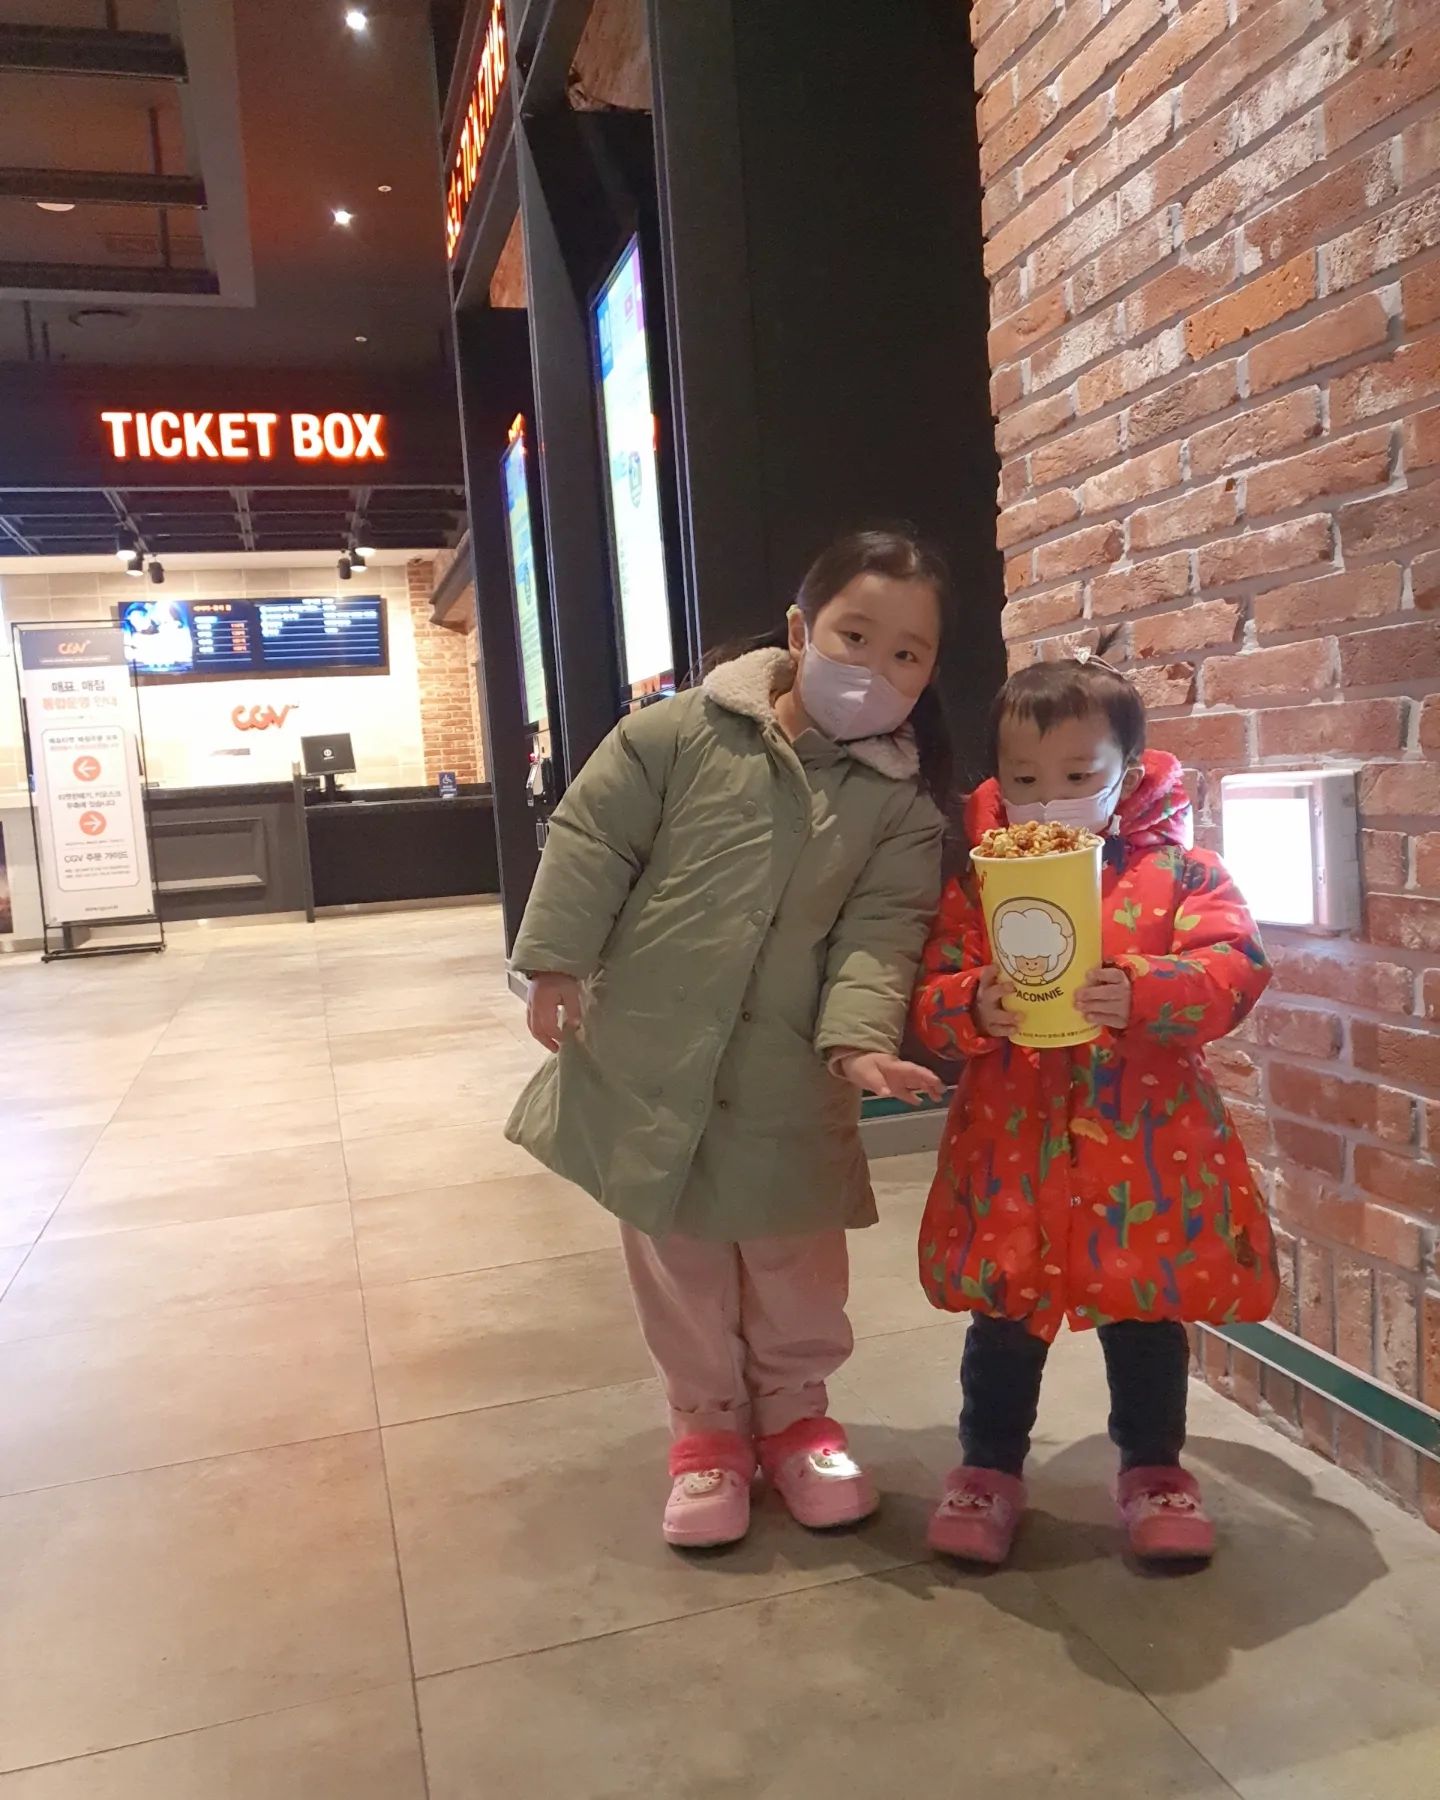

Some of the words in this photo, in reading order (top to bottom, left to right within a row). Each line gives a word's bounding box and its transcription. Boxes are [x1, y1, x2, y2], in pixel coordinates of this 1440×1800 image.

[101, 411, 279, 458] TICKET
[290, 411, 385, 459] BOX
[58, 640, 92, 656] CGV
[81, 679, 105, 692] 매점
[231, 703, 298, 732] CGV
[64, 854, 84, 864] CGV
